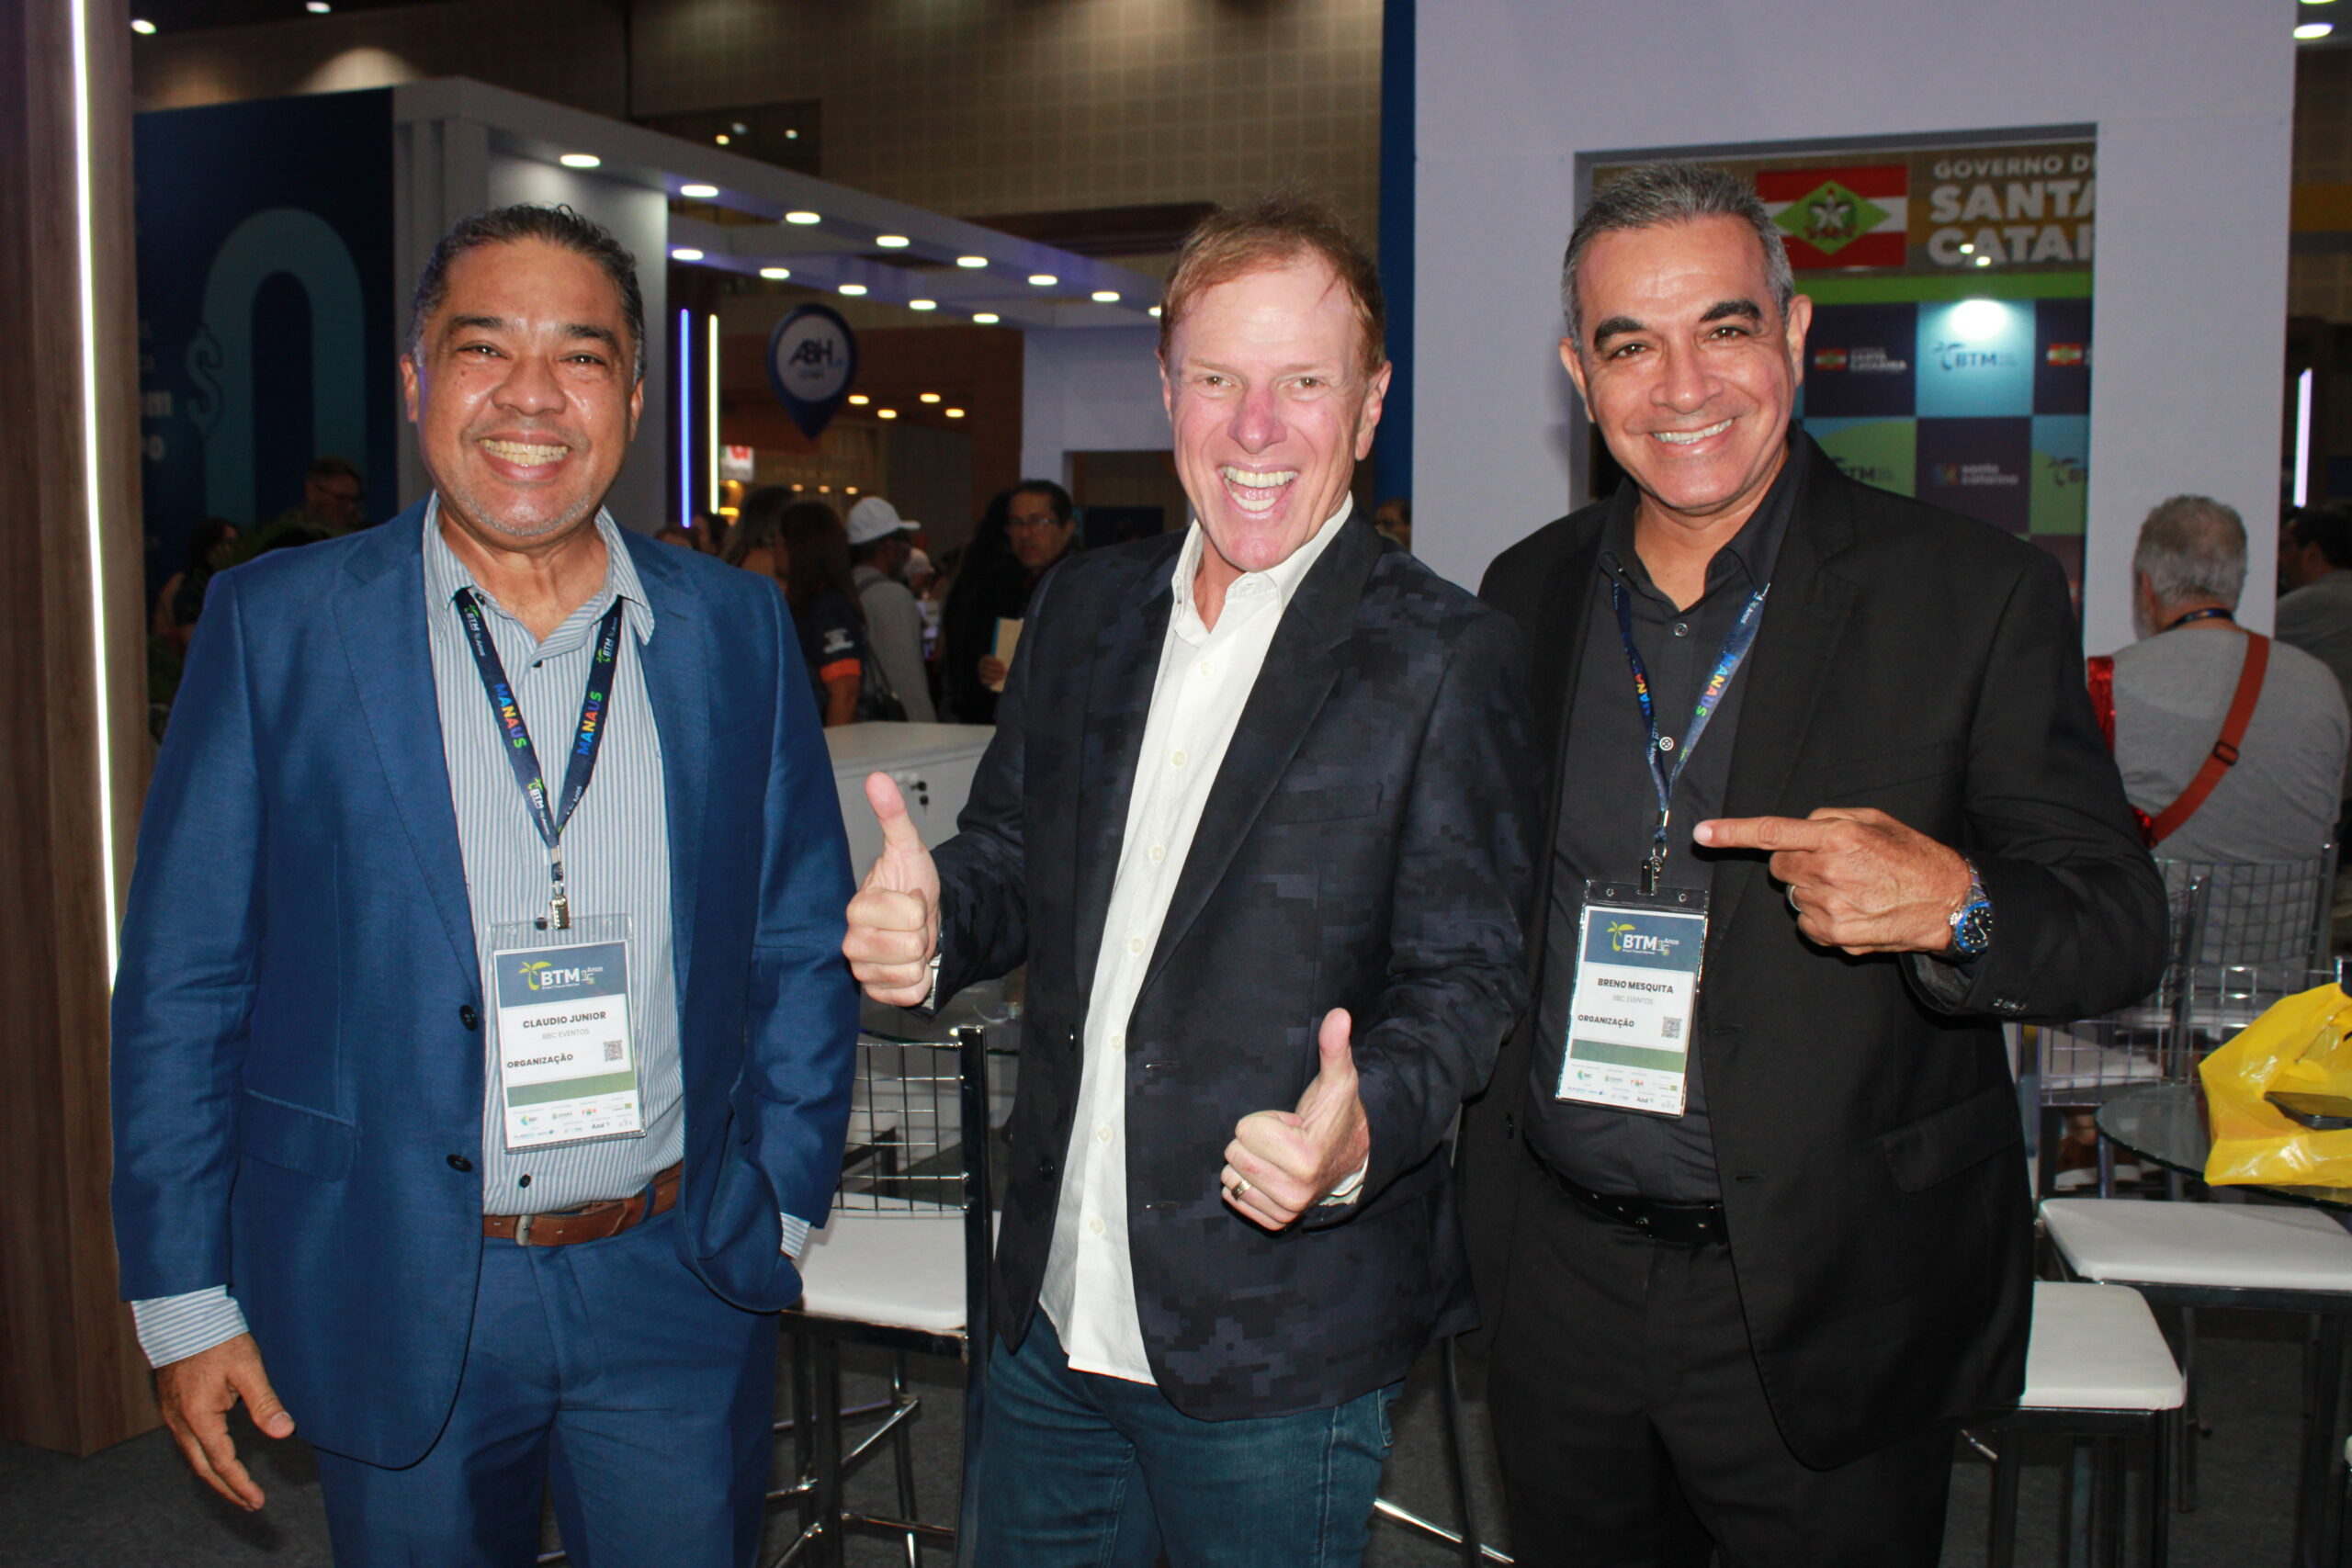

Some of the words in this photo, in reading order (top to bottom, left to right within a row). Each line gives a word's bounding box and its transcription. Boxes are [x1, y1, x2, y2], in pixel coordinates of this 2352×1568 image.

[1934, 154, 2064, 179] GOVERNO
[2071, 152, 2096, 173] D
[1955, 353, 1997, 367] BTM
[466, 613, 480, 631] BTM
[603, 637, 614, 658] BTM
[1695, 652, 1737, 717] MANAUS
[494, 682, 526, 748] MANAUS
[577, 691, 603, 756] MANAUS
[529, 788, 545, 808] BTM
[1623, 934, 1658, 951] BTM
[540, 967, 581, 986] BTM
[1598, 978, 1627, 988] BRENO
[1628, 981, 1674, 994] MESQUITA
[1626, 996, 1654, 1005] EVENTOS
[523, 1016, 568, 1029] CLAUDIO
[570, 1011, 606, 1023] JUNIOR
[1577, 1014, 1634, 1028] ORGANIZAÇÃO
[559, 1028, 590, 1038] EVENTOS
[507, 1053, 573, 1068] ORGANIZAÇÃO
